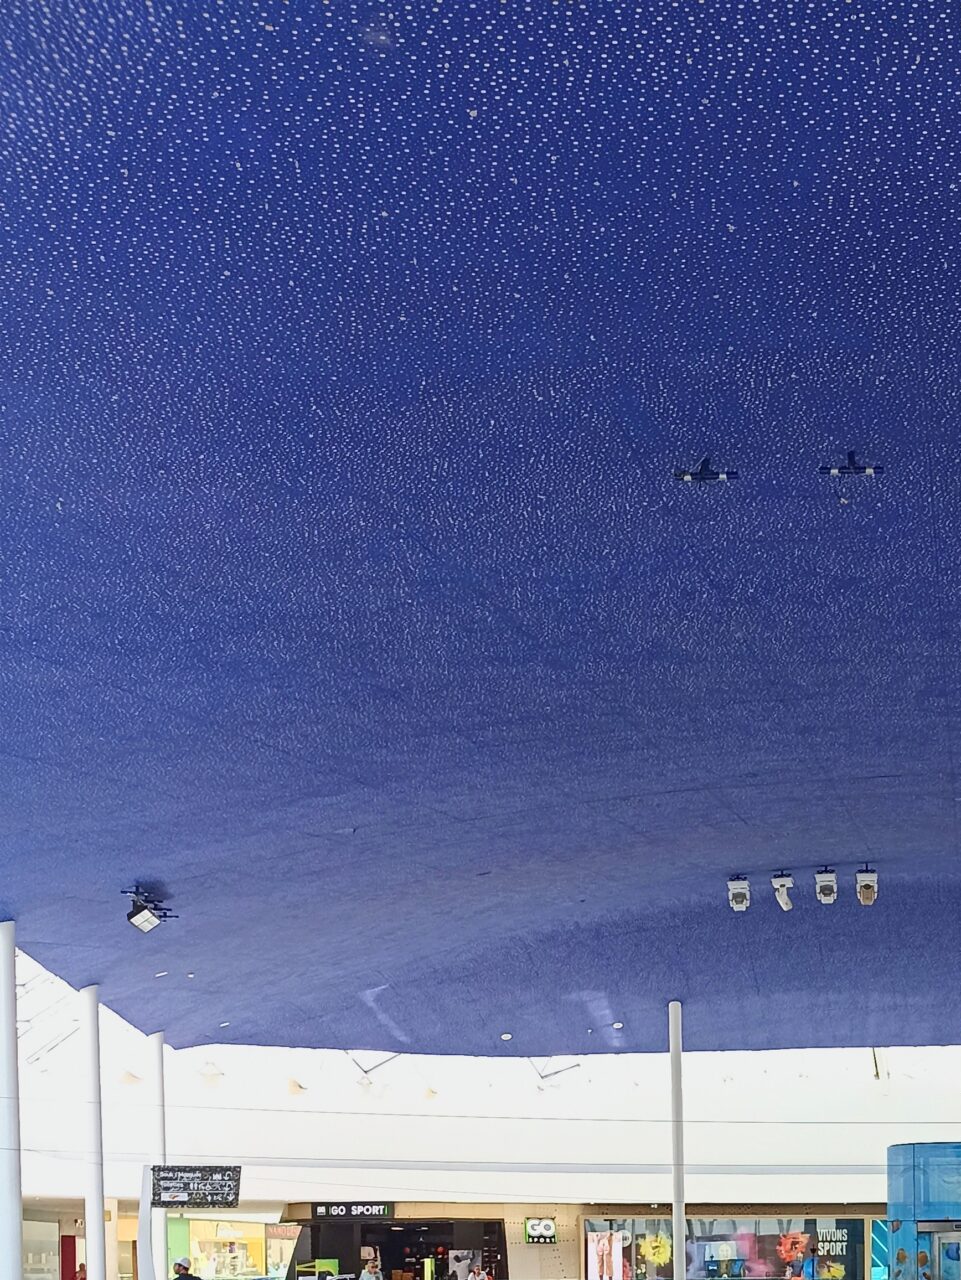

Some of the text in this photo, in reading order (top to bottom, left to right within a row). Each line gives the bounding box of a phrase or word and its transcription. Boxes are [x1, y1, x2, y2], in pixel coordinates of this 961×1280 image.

[331, 1205, 385, 1215] GO SPORT
[526, 1218, 556, 1237] GO
[817, 1228, 848, 1241] VIVONS
[817, 1241, 848, 1256] SPORT
